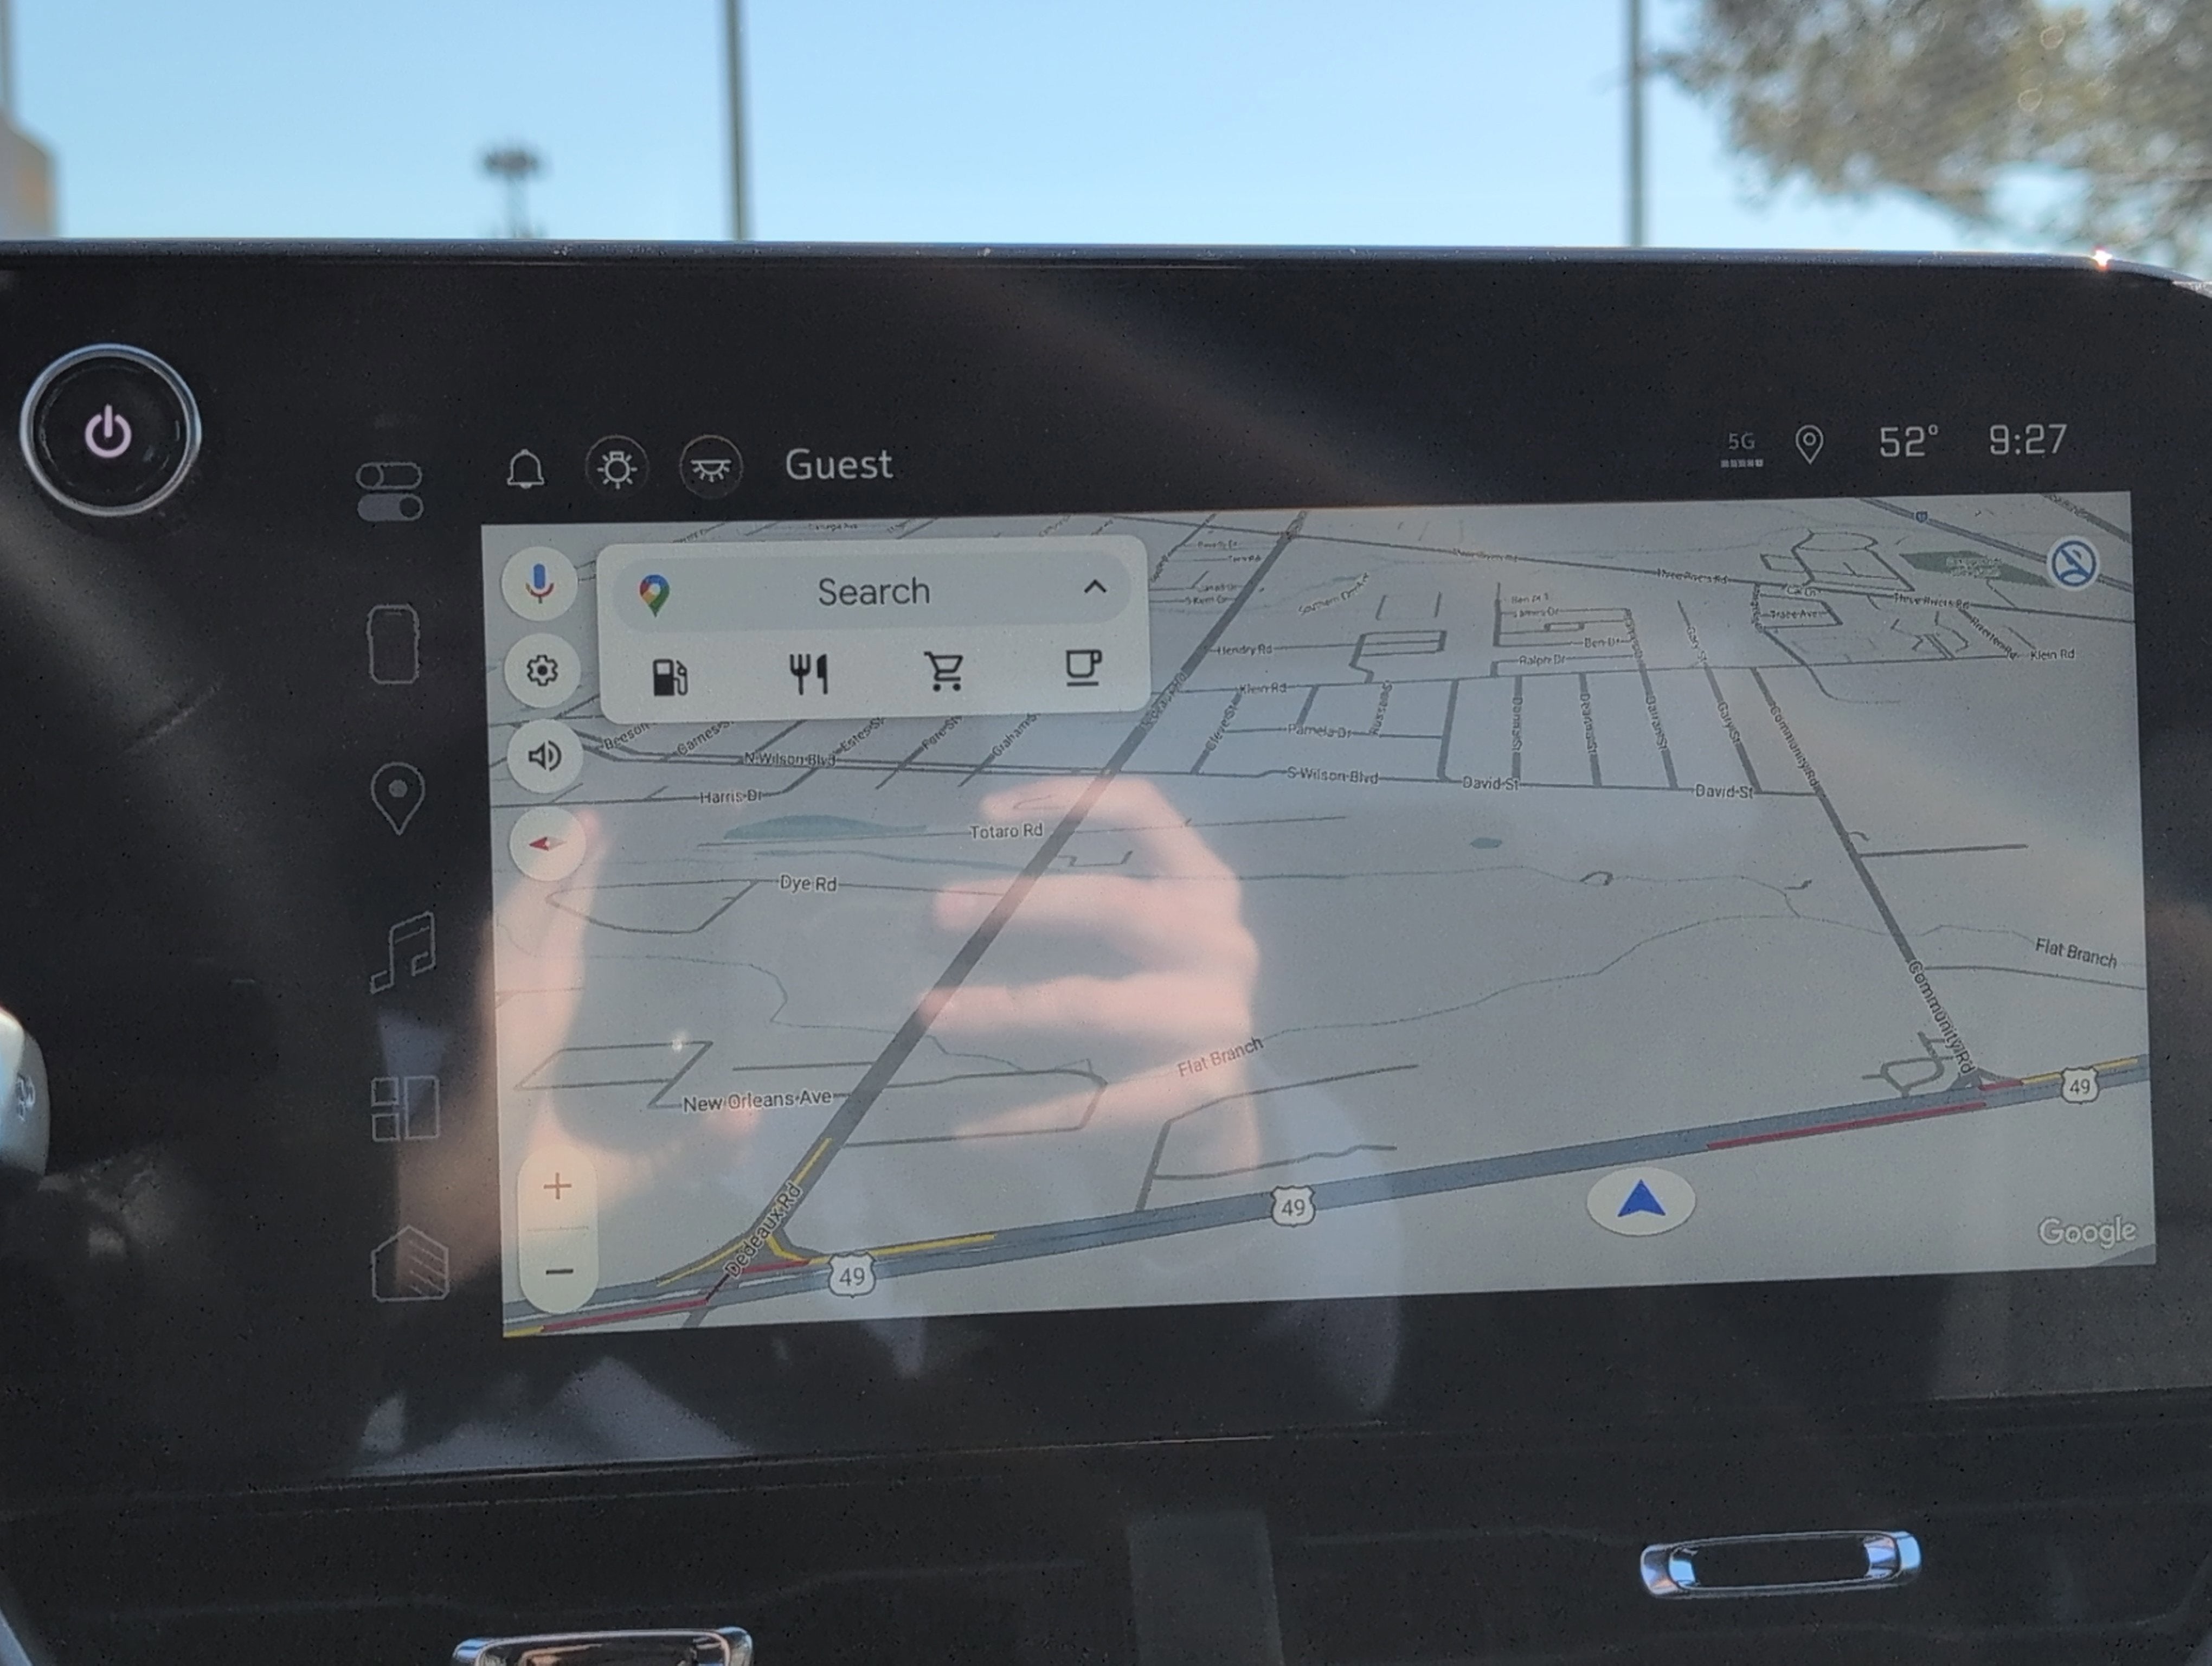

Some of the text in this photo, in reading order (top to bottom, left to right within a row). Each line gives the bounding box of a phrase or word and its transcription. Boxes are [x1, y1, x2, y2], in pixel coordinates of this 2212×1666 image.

[1728, 432, 1756, 450] 5G
[1879, 424, 1939, 457] 52°
[1989, 424, 2068, 456] 9:27
[785, 448, 895, 480] Guest
[819, 576, 930, 606] Search
[1956, 599, 1970, 610] Rd
[1258, 643, 1273, 655] Rd
[2030, 648, 2075, 661] Klein Rd
[1271, 681, 1287, 693] Rd
[1224, 704, 1238, 720] St
[1337, 726, 1352, 739] Dr
[1718, 701, 1741, 745] Gary St
[603, 722, 651, 750] Beeson
[992, 720, 1030, 757] Graham
[1512, 738, 1523, 752] St
[1586, 740, 1598, 754] St
[1770, 706, 1820, 787] Community Rd
[744, 751, 837, 767] N Wilson Blvd
[1287, 766, 1379, 785] S Wilson Blvd
[1462, 776, 1520, 791] David St
[699, 789, 762, 805] Harris Dr
[1695, 783, 1754, 799] David St
[969, 823, 1043, 840] Totaro Rd
[780, 874, 837, 893] Dye Rd
[2035, 936, 2118, 969] Flat Branch
[1908, 959, 1977, 1074] Community Rd
[1177, 1035, 1265, 1078] Flat Branch
[2069, 1078, 2091, 1095] 49
[683, 1090, 832, 1112] New Orleans Ave
[1281, 1199, 1306, 1217] 49
[724, 1180, 802, 1279] Dedeaux Rd
[2037, 1214, 2138, 1250] Google
[839, 1266, 866, 1287] 49
